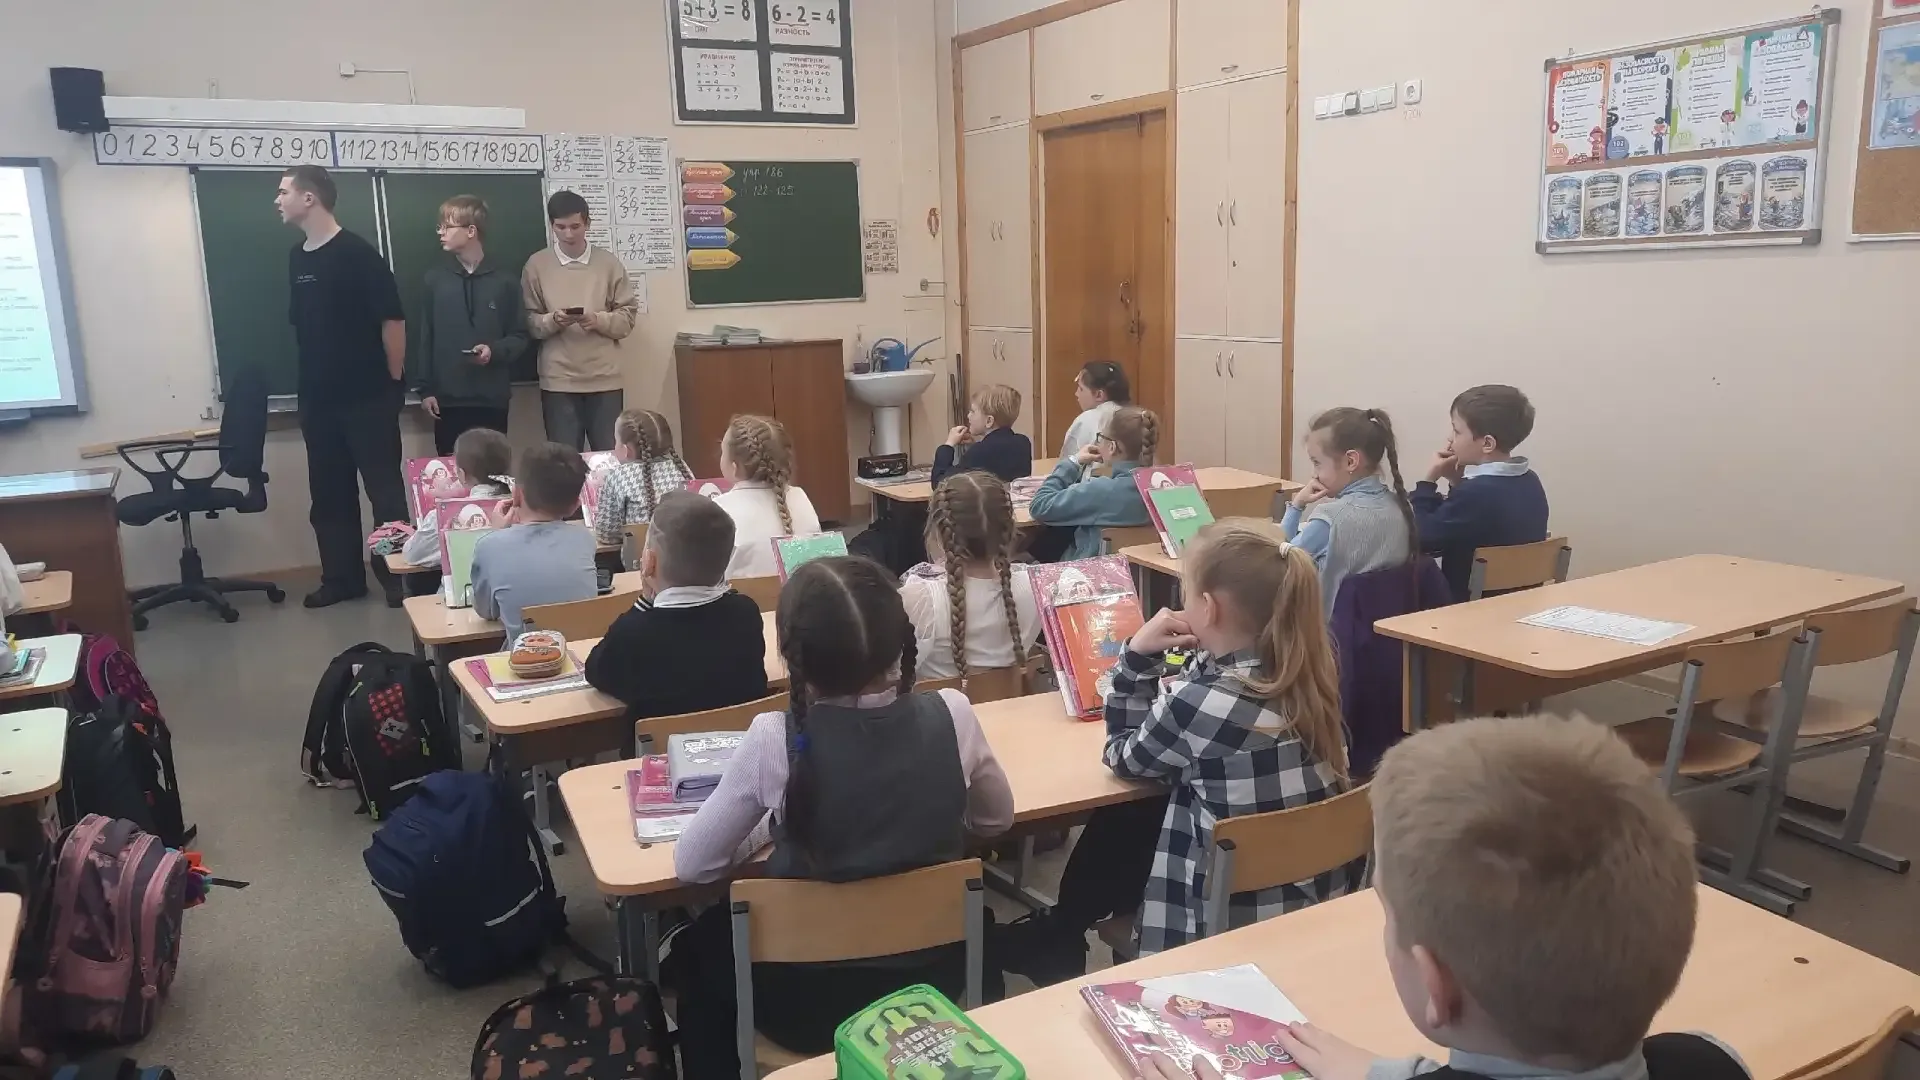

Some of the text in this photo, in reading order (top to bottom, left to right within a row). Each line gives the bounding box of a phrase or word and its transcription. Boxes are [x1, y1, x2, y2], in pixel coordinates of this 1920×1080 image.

[741, 0, 751, 22] 8
[772, 4, 782, 22] 6
[797, 5, 807, 23] 2
[826, 9, 836, 25] 4
[775, 27, 811, 36] РАЗНОСТЬ
[103, 133, 329, 160] 0 1 2 3 4 5 6 7 8 9 10
[340, 139, 539, 163] 11 12 13 14 15 16 17 18 19 20
[553, 139, 571, 151] 37
[617, 186, 637, 198] 57
[620, 196, 638, 208] 26
